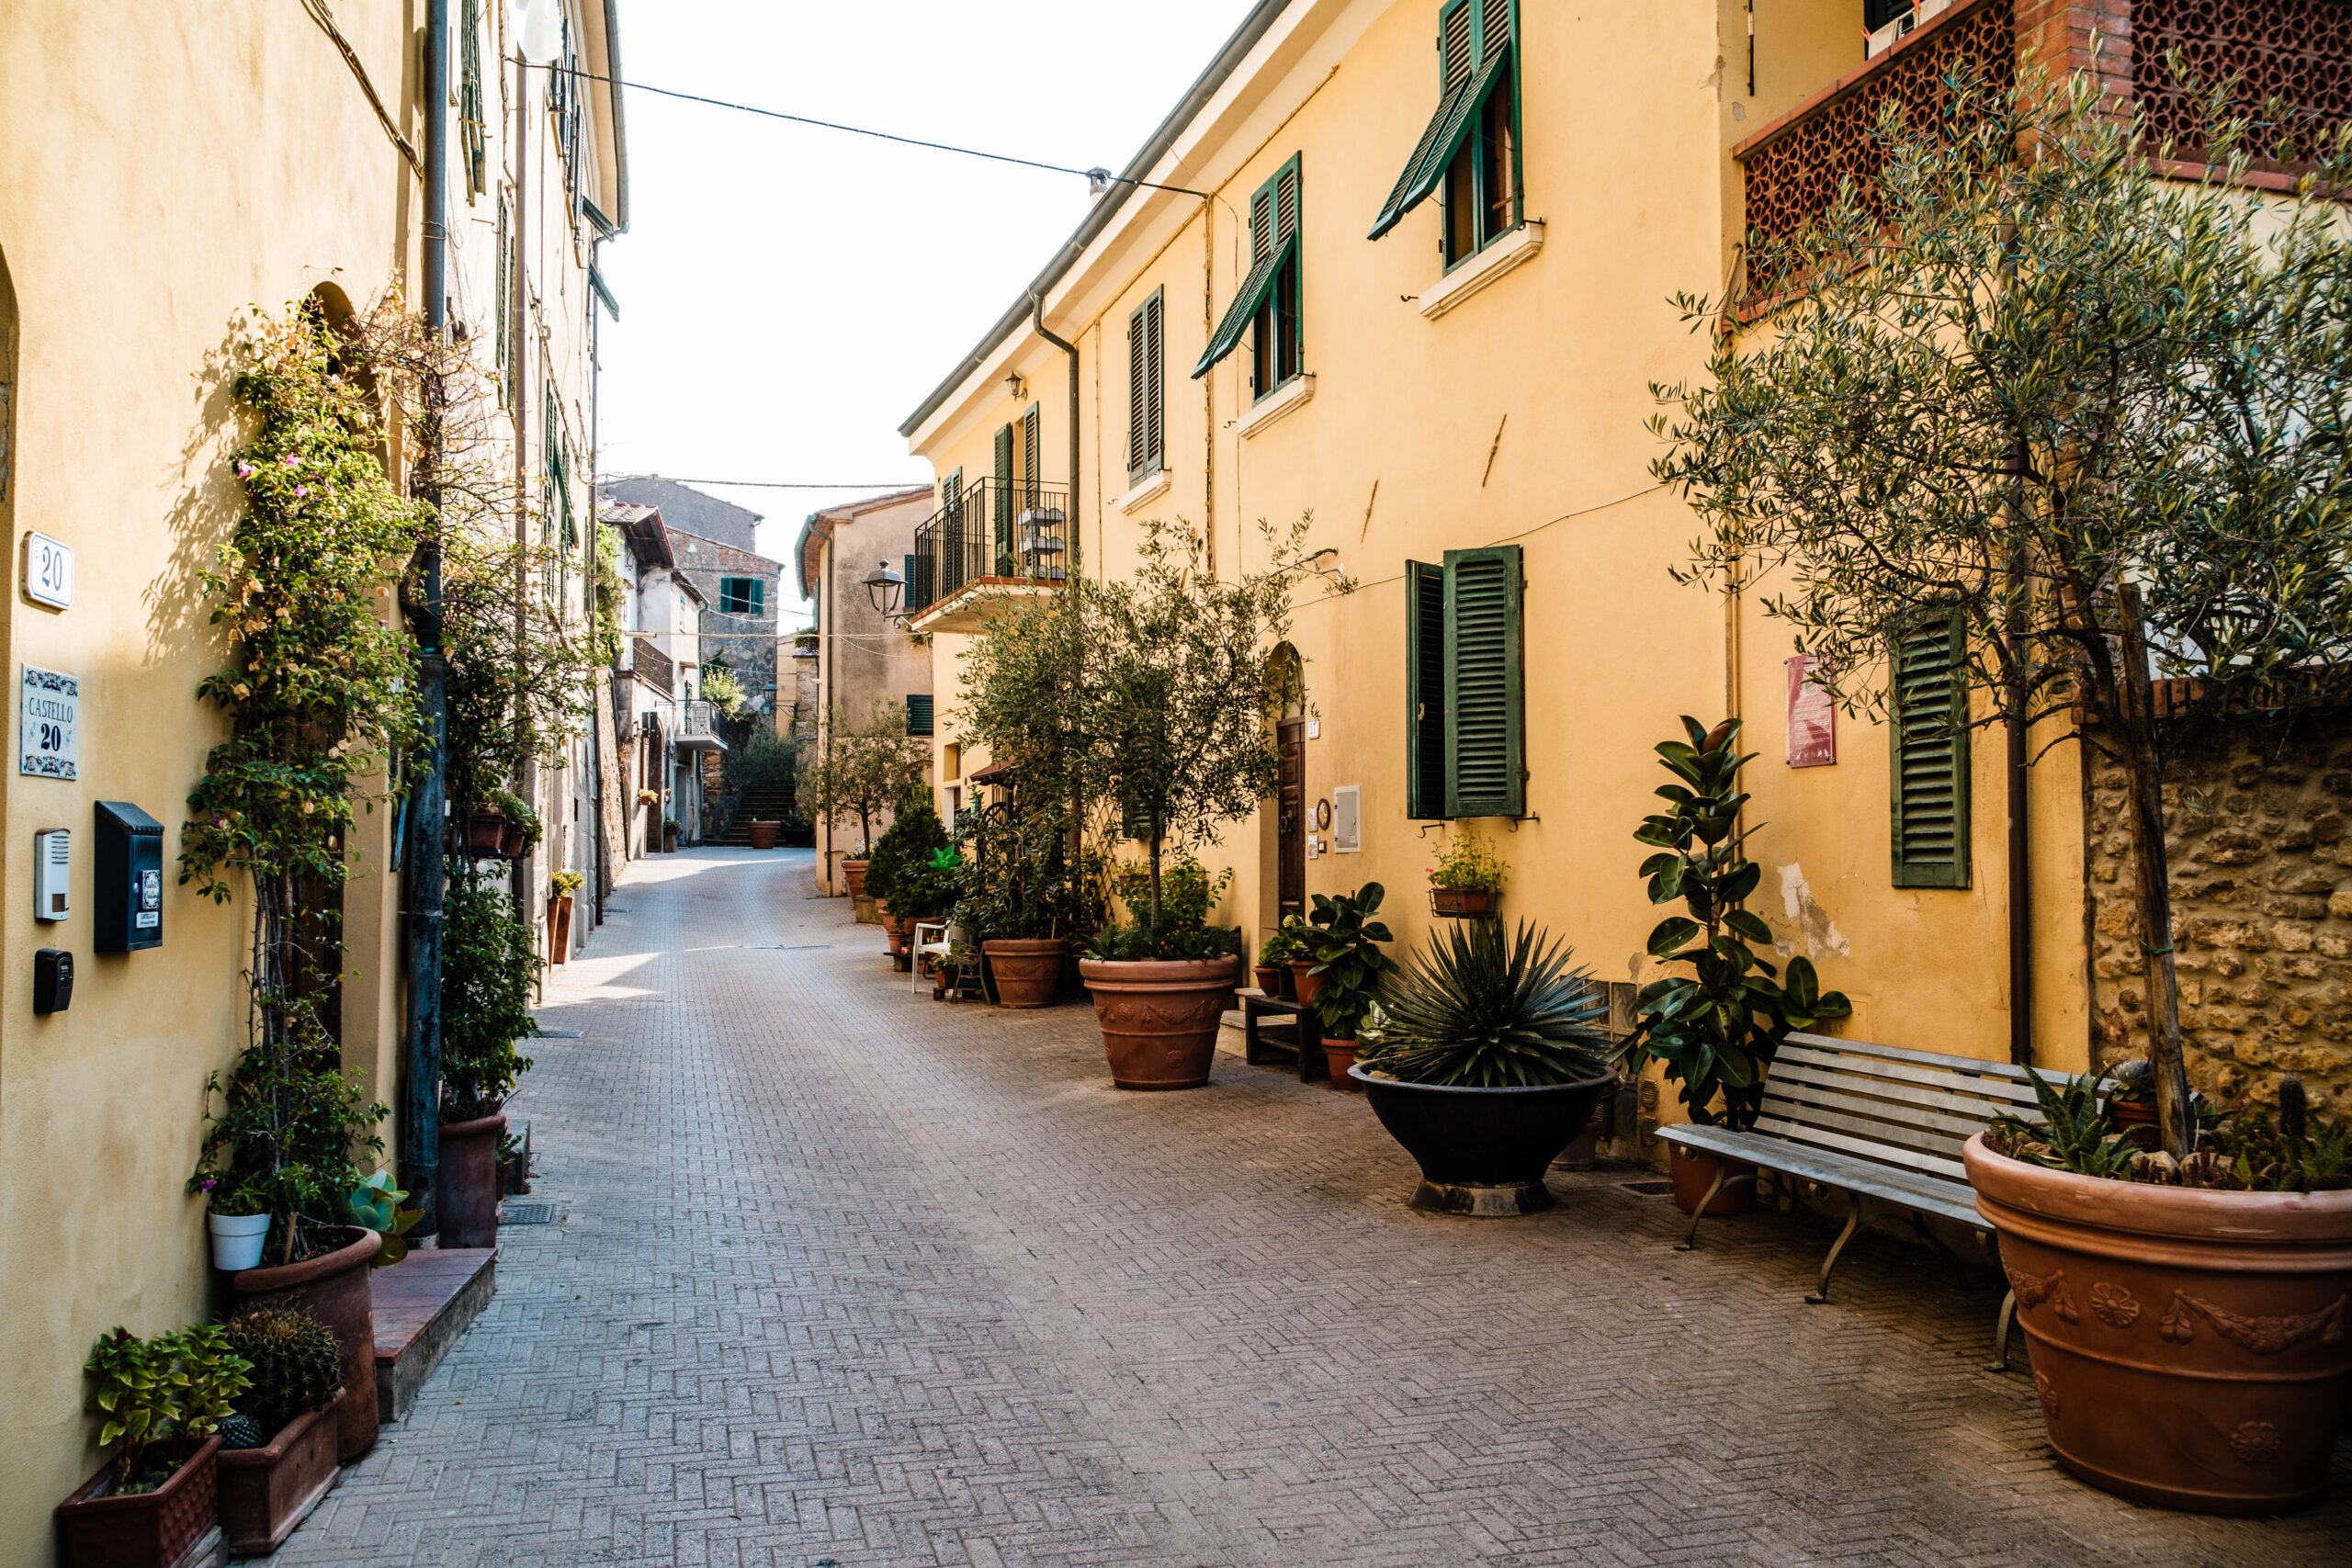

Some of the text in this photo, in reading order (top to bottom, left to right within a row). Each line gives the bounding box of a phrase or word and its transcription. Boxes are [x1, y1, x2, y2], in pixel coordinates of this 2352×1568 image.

[42, 546, 62, 592] 20
[28, 697, 74, 724] CASTELLO
[40, 723, 62, 752] 20
[1826, 1021, 1844, 1035] GAS
